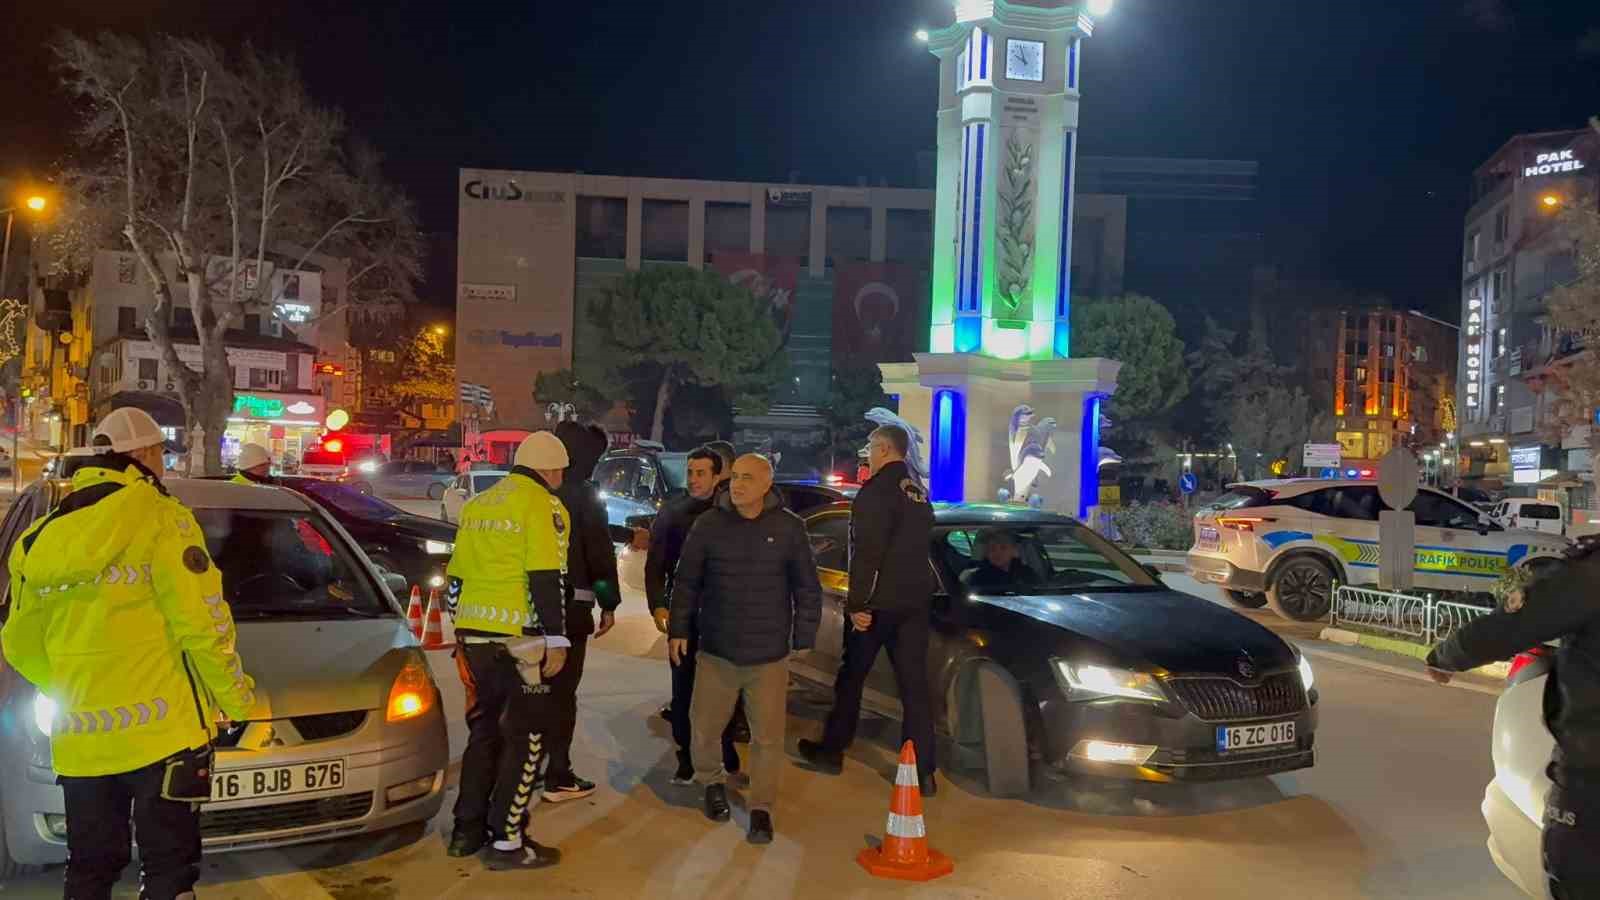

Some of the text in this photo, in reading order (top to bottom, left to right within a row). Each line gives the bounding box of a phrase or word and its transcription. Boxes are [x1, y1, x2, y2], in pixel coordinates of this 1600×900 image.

[1525, 160, 1584, 176] HOTEL
[1536, 150, 1573, 164] PAK
[1467, 344, 1479, 406] HOTEL
[1228, 724, 1293, 746] 16 ZC 016
[213, 761, 341, 798] 16 BJB 676
